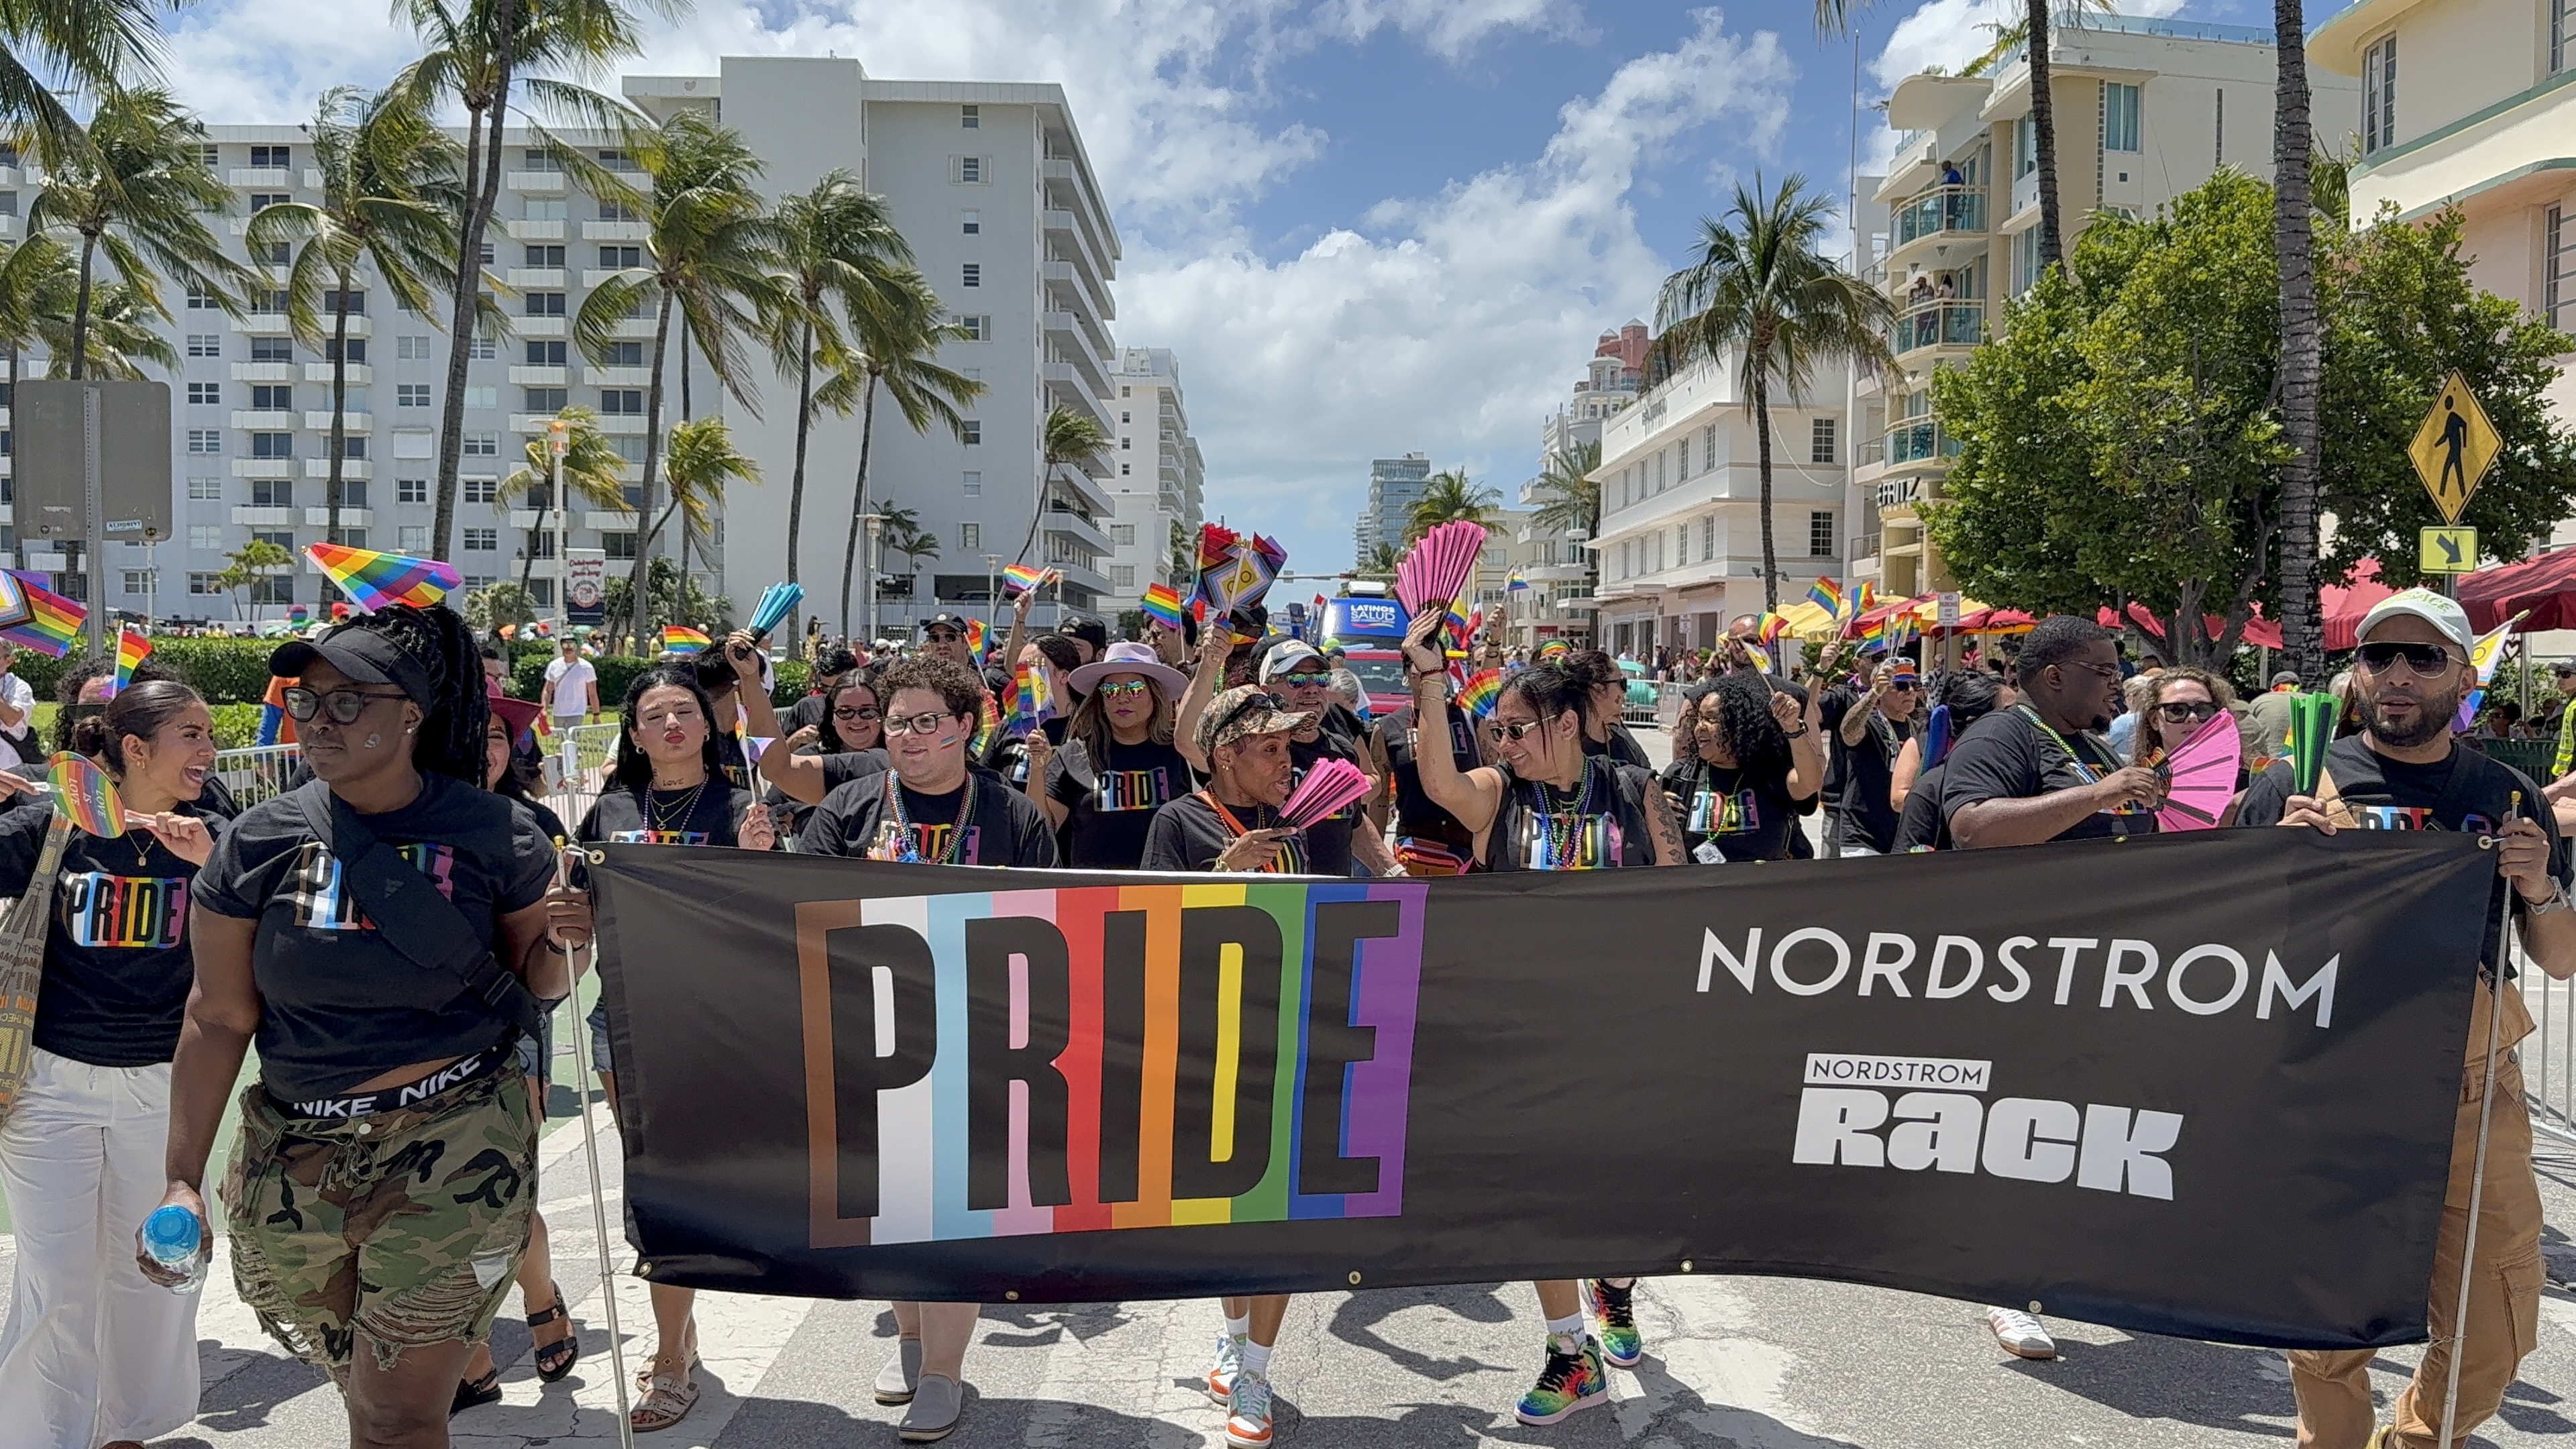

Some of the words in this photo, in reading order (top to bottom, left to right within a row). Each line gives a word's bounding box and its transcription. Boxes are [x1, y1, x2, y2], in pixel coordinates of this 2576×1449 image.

[1350, 604, 1395, 613] LATINOS
[1350, 610, 1396, 621] SALUD
[68, 776, 80, 806] LOVE
[83, 792, 92, 804] IS
[97, 788, 106, 818] LOVE
[1093, 766, 1170, 812] PRIDE
[65, 872, 187, 949] PRIDE
[1696, 926, 2340, 1028] NORDSTROM
[825, 900, 1401, 1220] PRIDE
[1811, 1059, 1984, 1085] NORDSTROM
[400, 1053, 481, 1107] NIKE
[294, 1095, 377, 1117] NIKE
